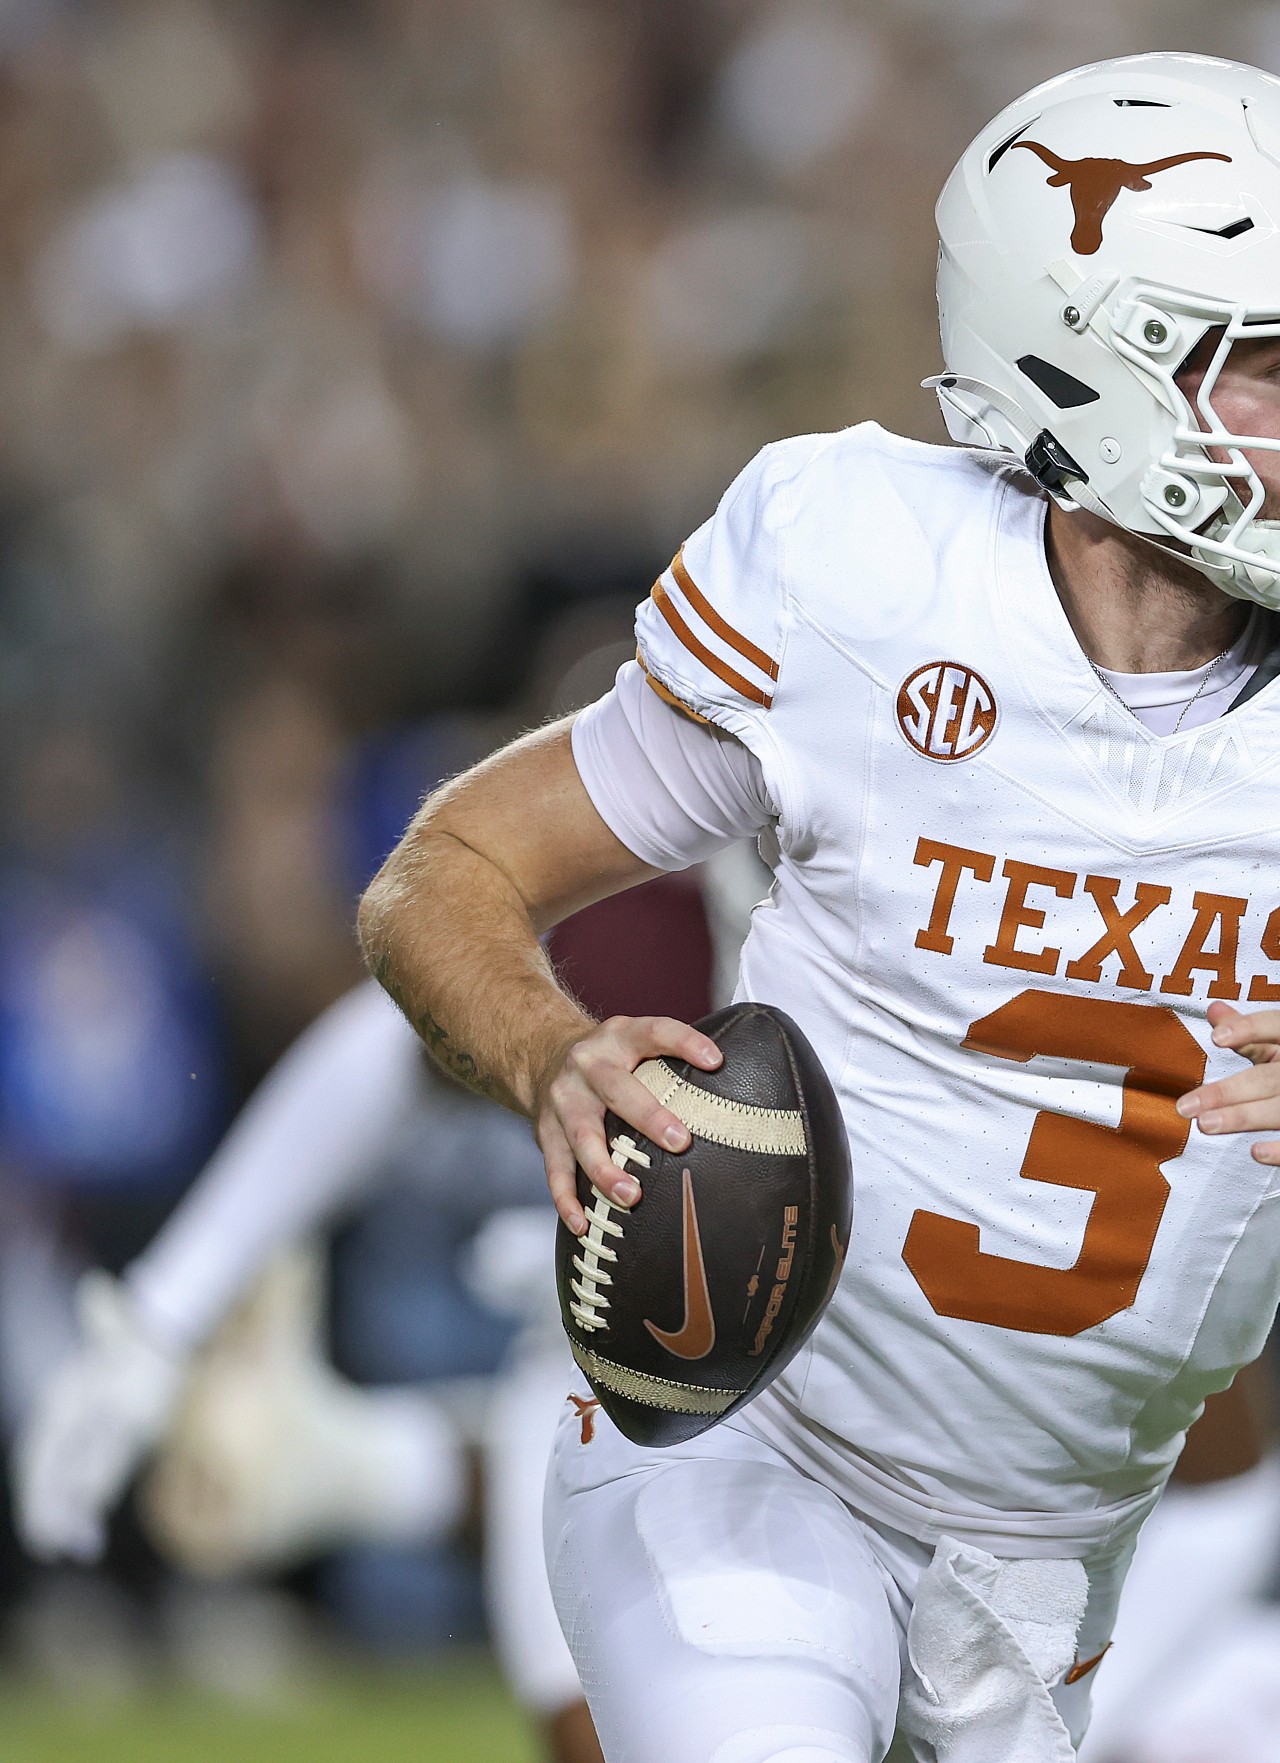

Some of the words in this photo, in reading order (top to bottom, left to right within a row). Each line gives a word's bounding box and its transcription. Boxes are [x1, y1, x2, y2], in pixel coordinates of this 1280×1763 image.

[901, 665, 993, 756] SEC
[901, 988, 1208, 1337] 3
[747, 1282, 788, 1356] VAPOR
[775, 1205, 799, 1281] ELITE
